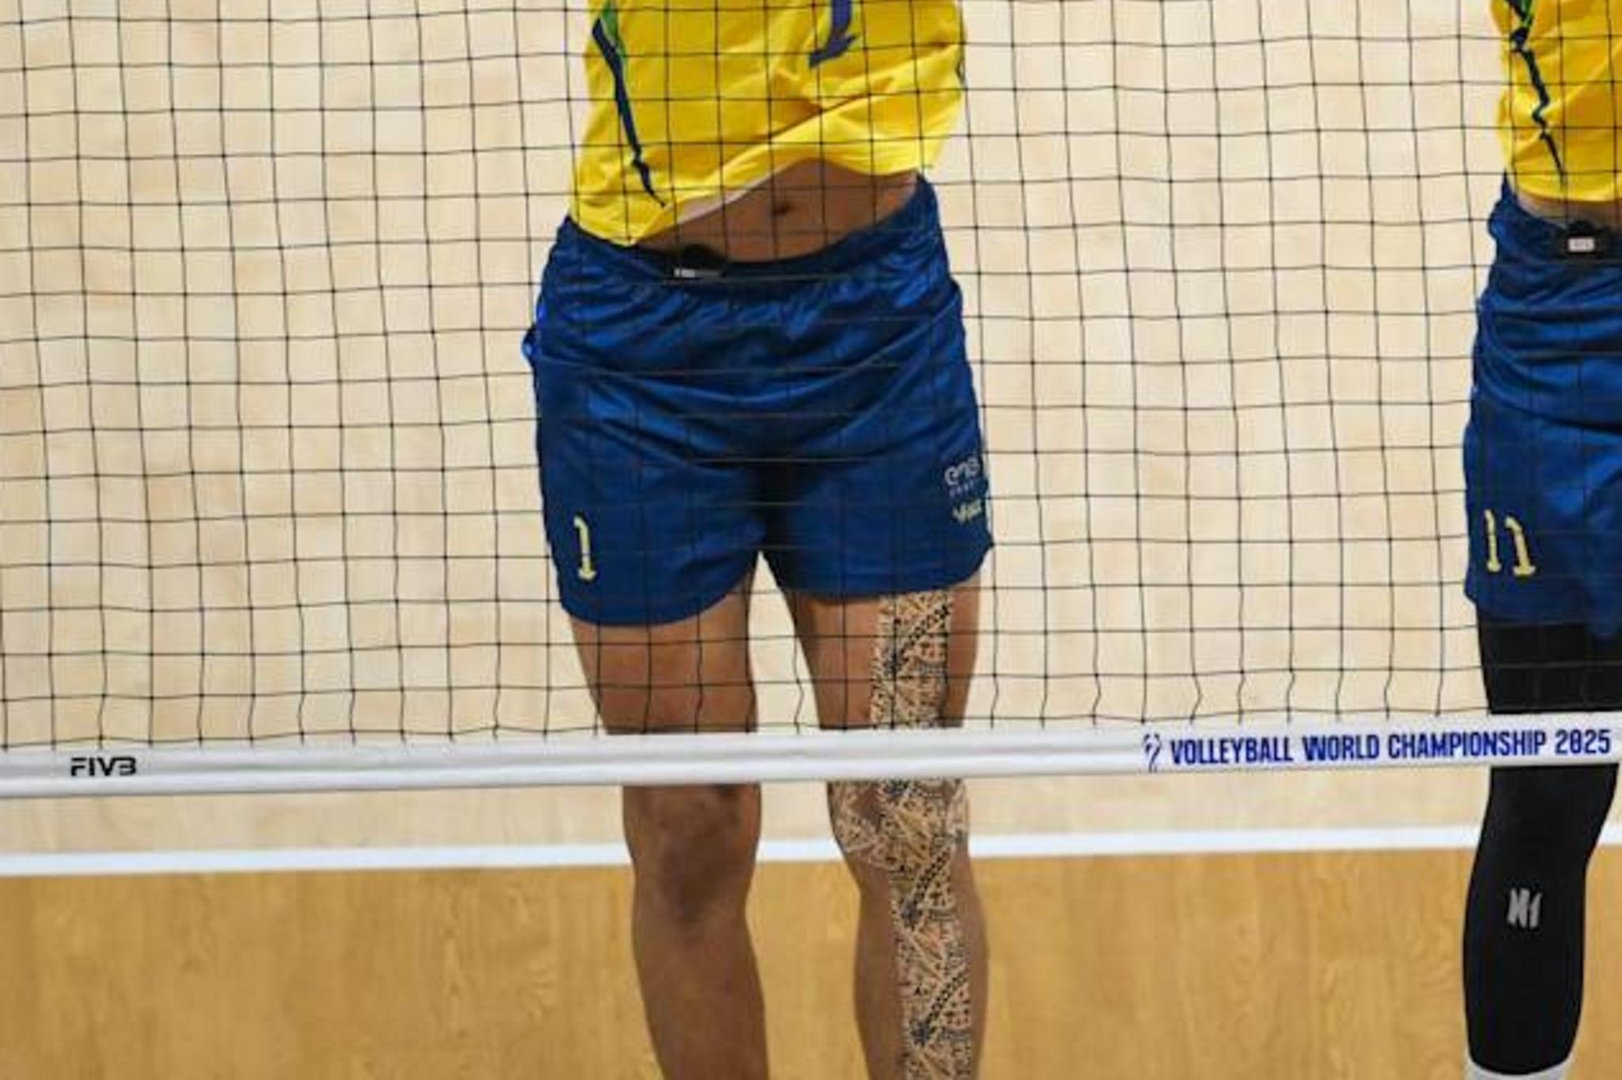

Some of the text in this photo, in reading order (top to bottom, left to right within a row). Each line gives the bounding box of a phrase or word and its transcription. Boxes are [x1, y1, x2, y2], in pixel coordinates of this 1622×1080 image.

[573, 516, 597, 581] 1
[1484, 509, 1537, 577] 11
[71, 757, 137, 777] FIVB
[1169, 729, 1612, 765] VOLLEYBALL WORLD CHAMPIONSHIP 2025
